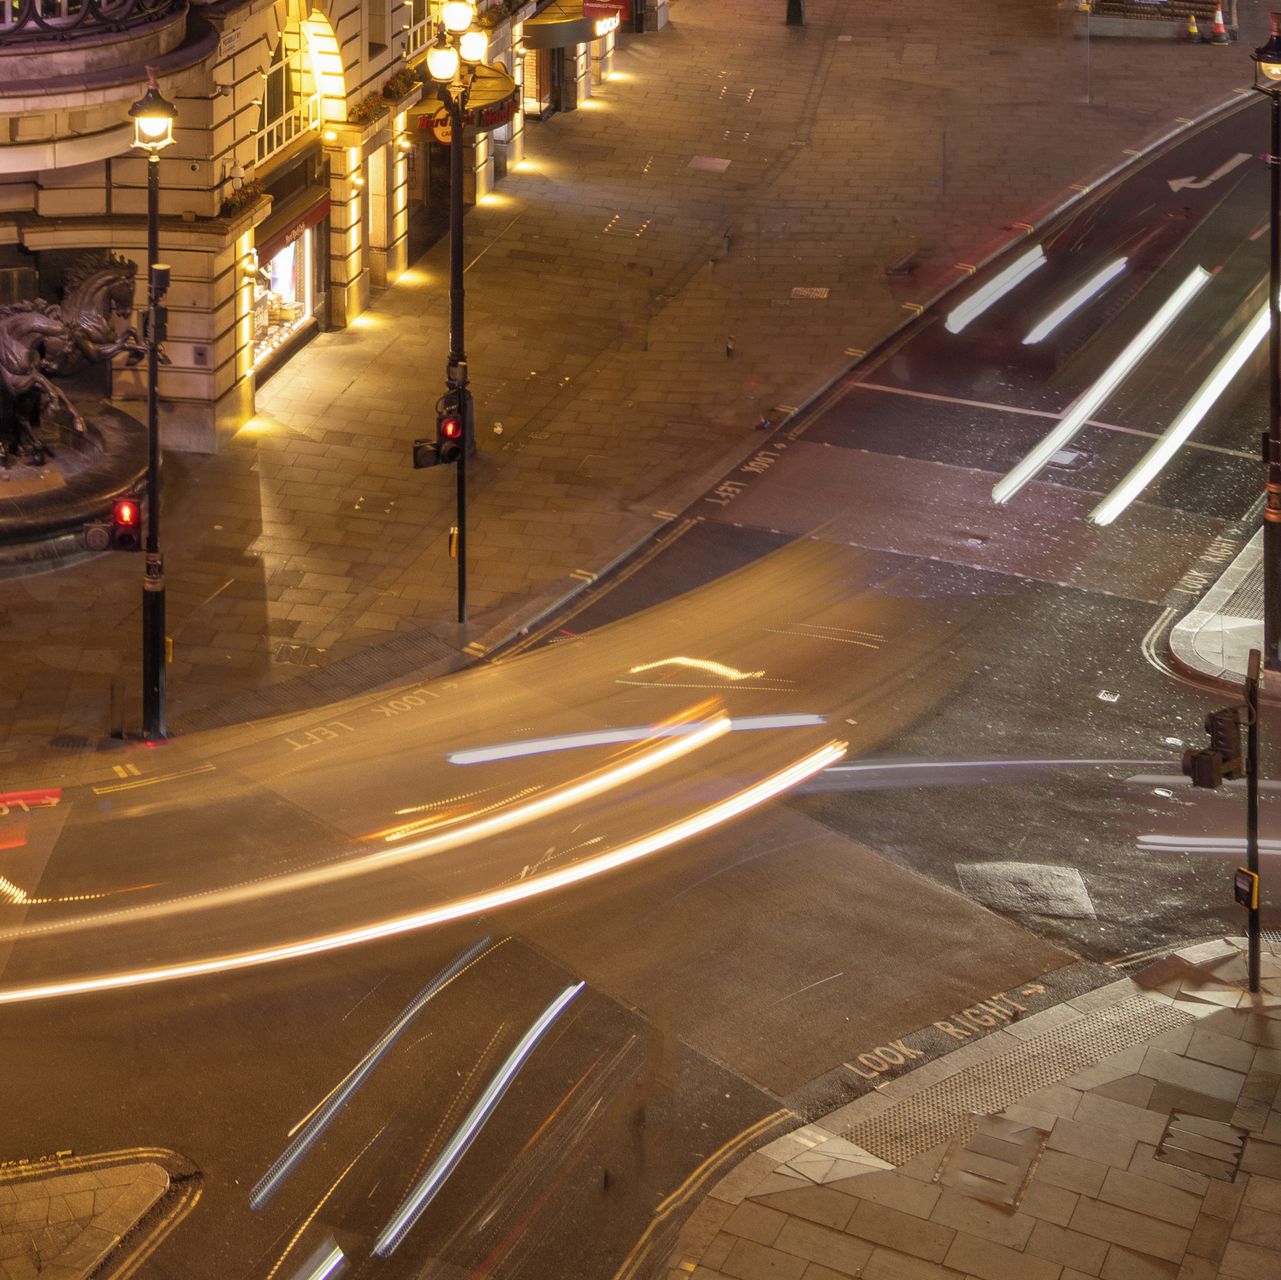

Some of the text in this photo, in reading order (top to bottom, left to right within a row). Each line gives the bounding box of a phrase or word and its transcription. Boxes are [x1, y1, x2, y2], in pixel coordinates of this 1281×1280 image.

[1173, 569, 1216, 595] LOOK
[285, 689, 440, 751] LOOK LEFT
[842, 991, 1027, 1081] LOOK RIGHT
